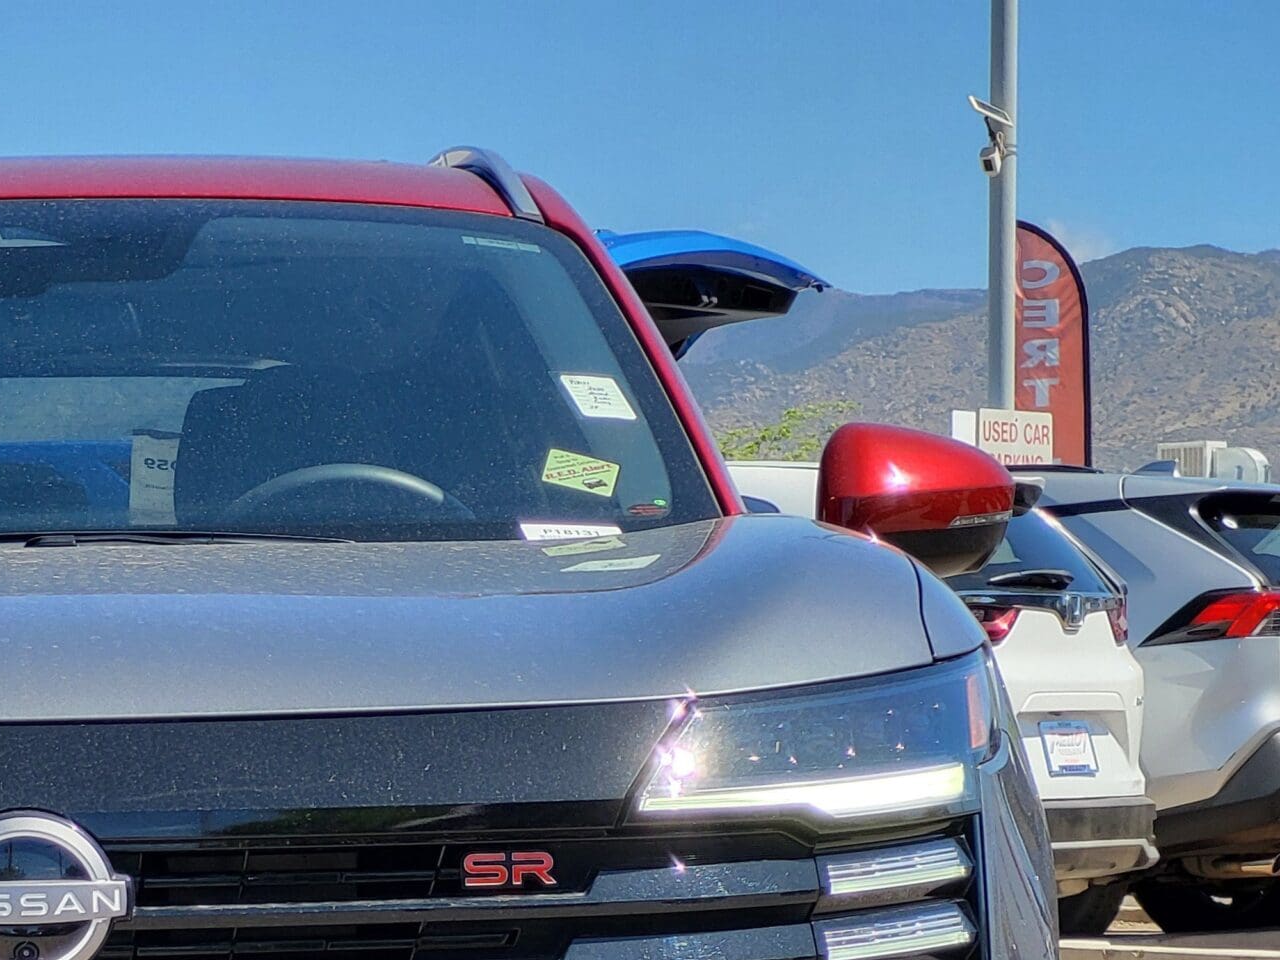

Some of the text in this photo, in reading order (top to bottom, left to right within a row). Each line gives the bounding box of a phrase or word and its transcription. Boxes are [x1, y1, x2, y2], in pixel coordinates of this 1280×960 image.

[983, 420, 1050, 445] USED CAR
[991, 452, 1044, 465] RKING
[463, 851, 558, 887] SR
